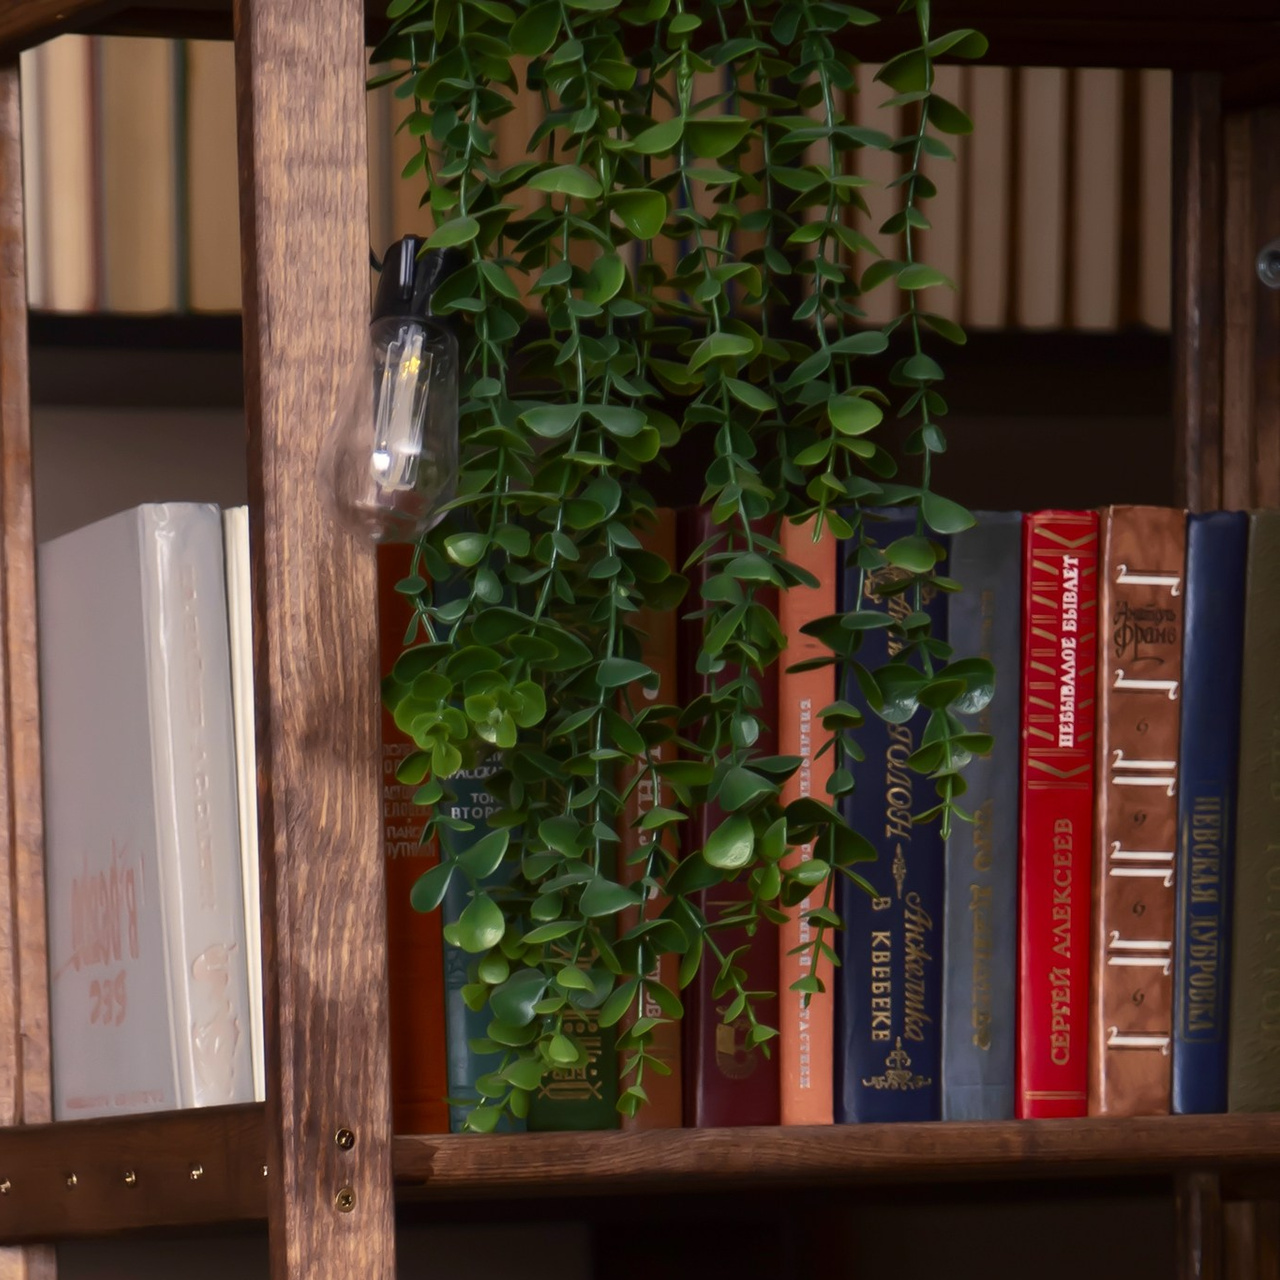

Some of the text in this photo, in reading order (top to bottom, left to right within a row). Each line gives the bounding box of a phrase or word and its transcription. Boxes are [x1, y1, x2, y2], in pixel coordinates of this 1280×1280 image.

[1058, 555, 1079, 748] НЕБЫВАЛОЕ БЫВАЕТ
[451, 807, 503, 819] ВТОР
[871, 896, 891, 1041] В КВЕБЕКЕ
[903, 892, 933, 1041] Анжелика
[1049, 818, 1073, 1066] СЕРГЕЙ АЛЕКСЕЕВ
[1188, 796, 1221, 1032] НЕВСКАЯ ДУБРОВКА
